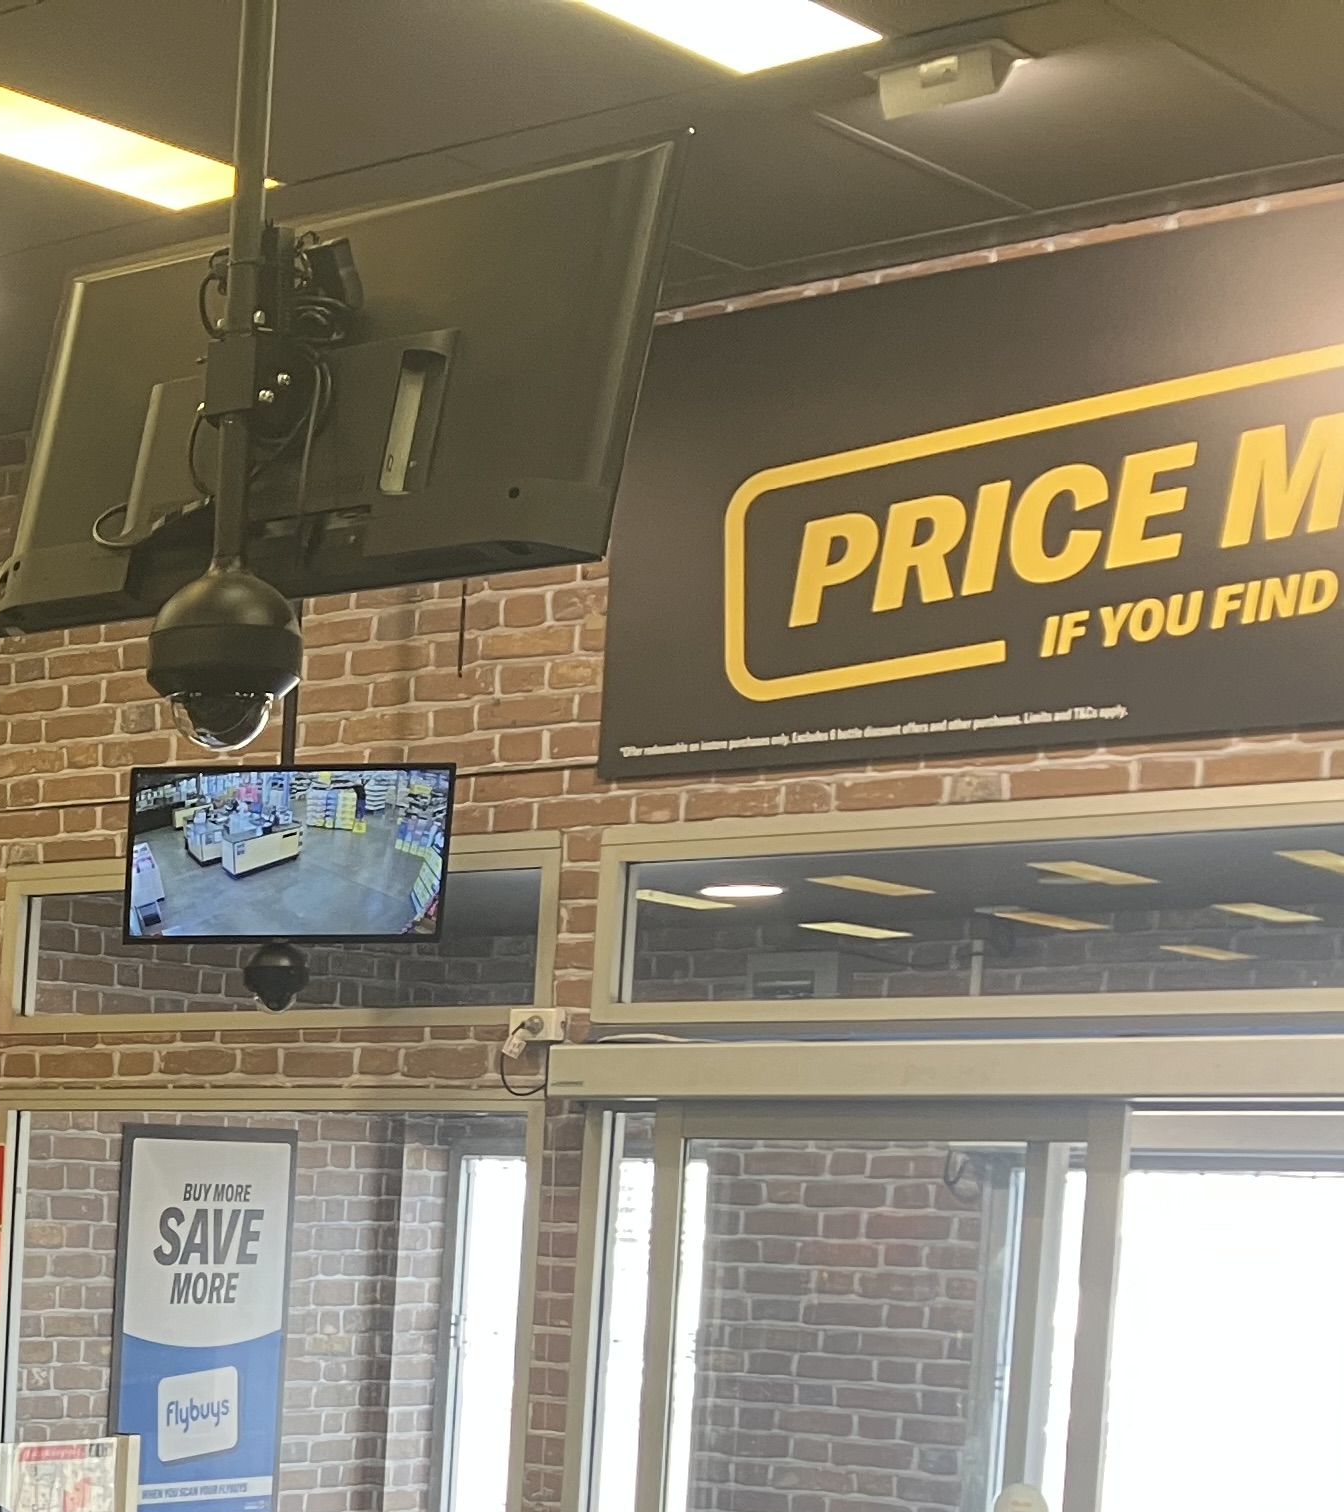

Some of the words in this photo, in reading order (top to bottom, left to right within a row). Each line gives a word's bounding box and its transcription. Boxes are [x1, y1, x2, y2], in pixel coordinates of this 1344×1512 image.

[788, 441, 1198, 628] PRICE
[1040, 610, 1090, 658] IF
[1101, 590, 1202, 647] YOU
[1211, 568, 1339, 629] FIND
[183, 1183, 212, 1202] BUY
[213, 1184, 252, 1202] MORE
[153, 1206, 264, 1266] SAVE
[169, 1271, 239, 1305] MORE
[166, 1397, 230, 1432] flybuys
[164, 1486, 178, 1499] YOU
[179, 1485, 199, 1498] SCAN
